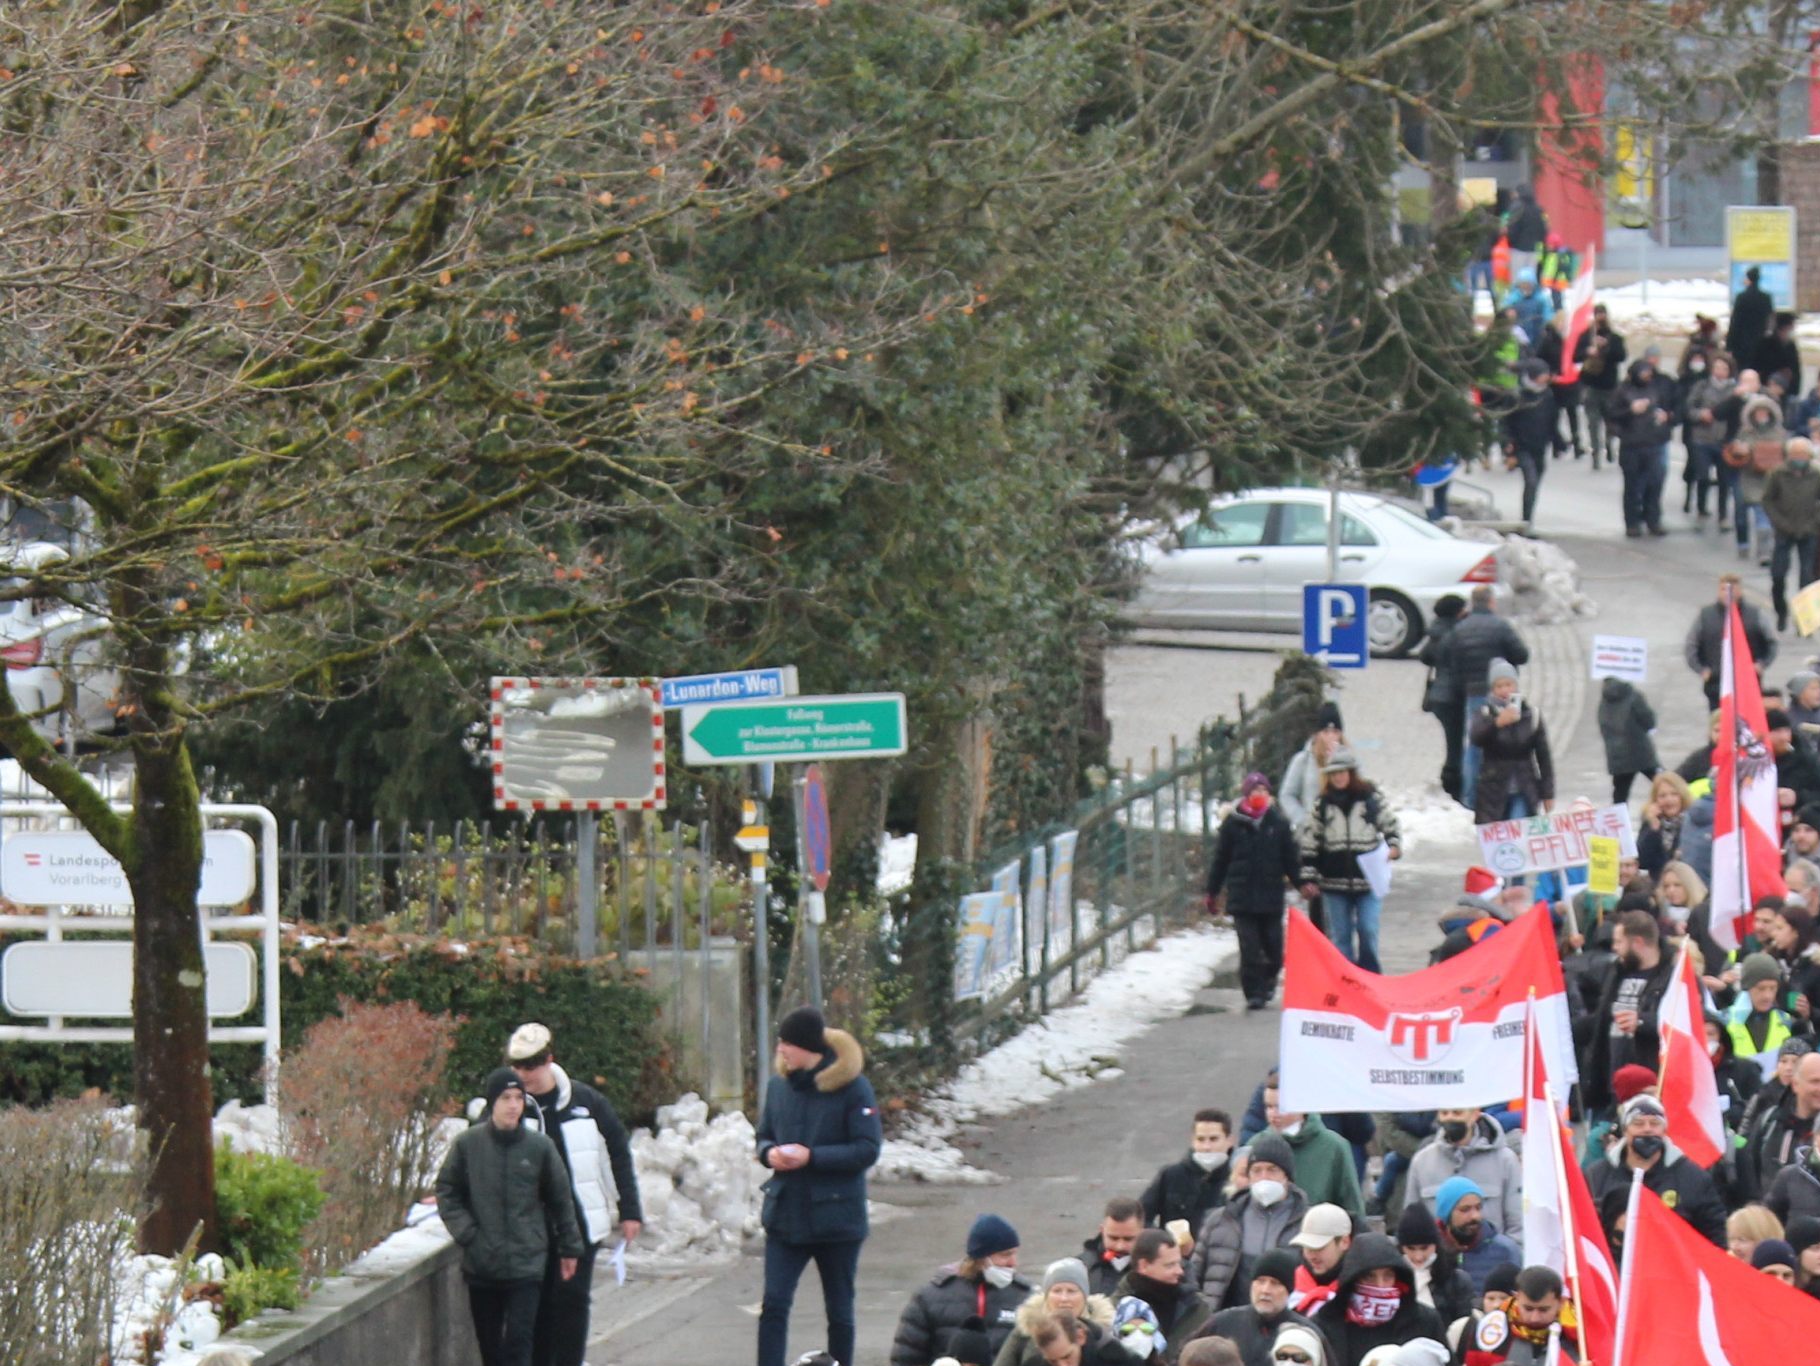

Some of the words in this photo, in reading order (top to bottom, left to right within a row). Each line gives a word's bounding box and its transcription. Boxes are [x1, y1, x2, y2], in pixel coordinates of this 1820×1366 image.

[1319, 589, 1356, 646] P
[665, 673, 779, 702] -Lunardon-Weg
[1482, 820, 1522, 843] NEIN
[50, 873, 122, 888] Vorarlberg
[1301, 1020, 1355, 1042] DEMOKRATIE
[1369, 1068, 1465, 1085] SELBSTBESTIMMUNG
